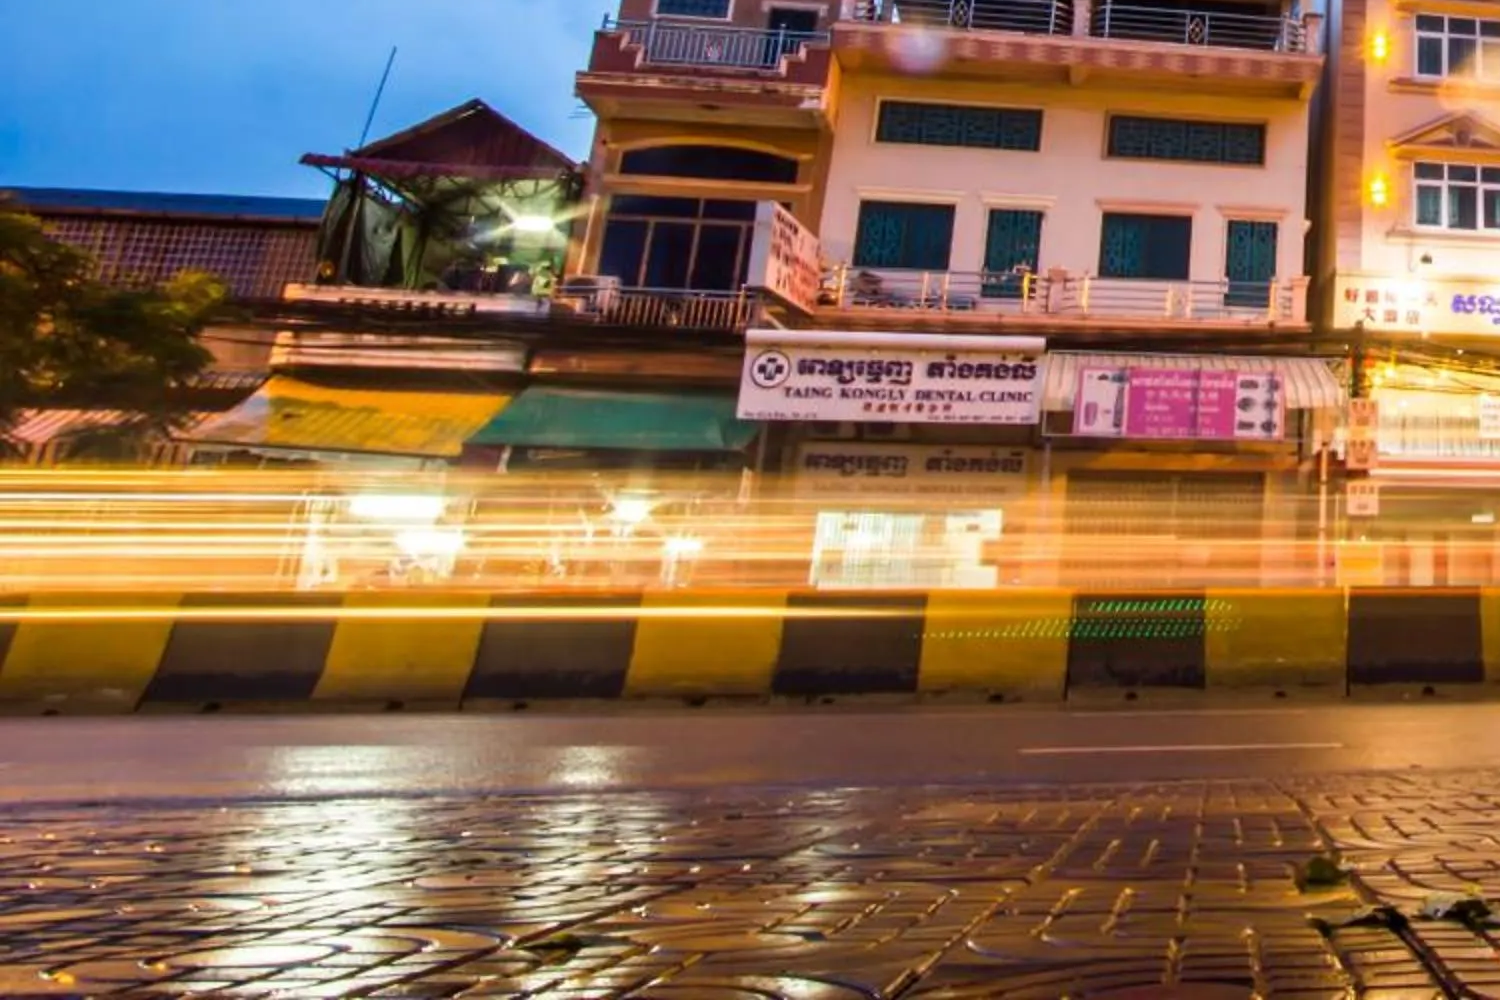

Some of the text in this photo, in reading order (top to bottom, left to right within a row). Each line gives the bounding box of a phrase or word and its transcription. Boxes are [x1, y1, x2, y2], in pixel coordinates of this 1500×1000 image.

[783, 385, 1034, 403] TAING KONGLY DENTAL CLINIC
